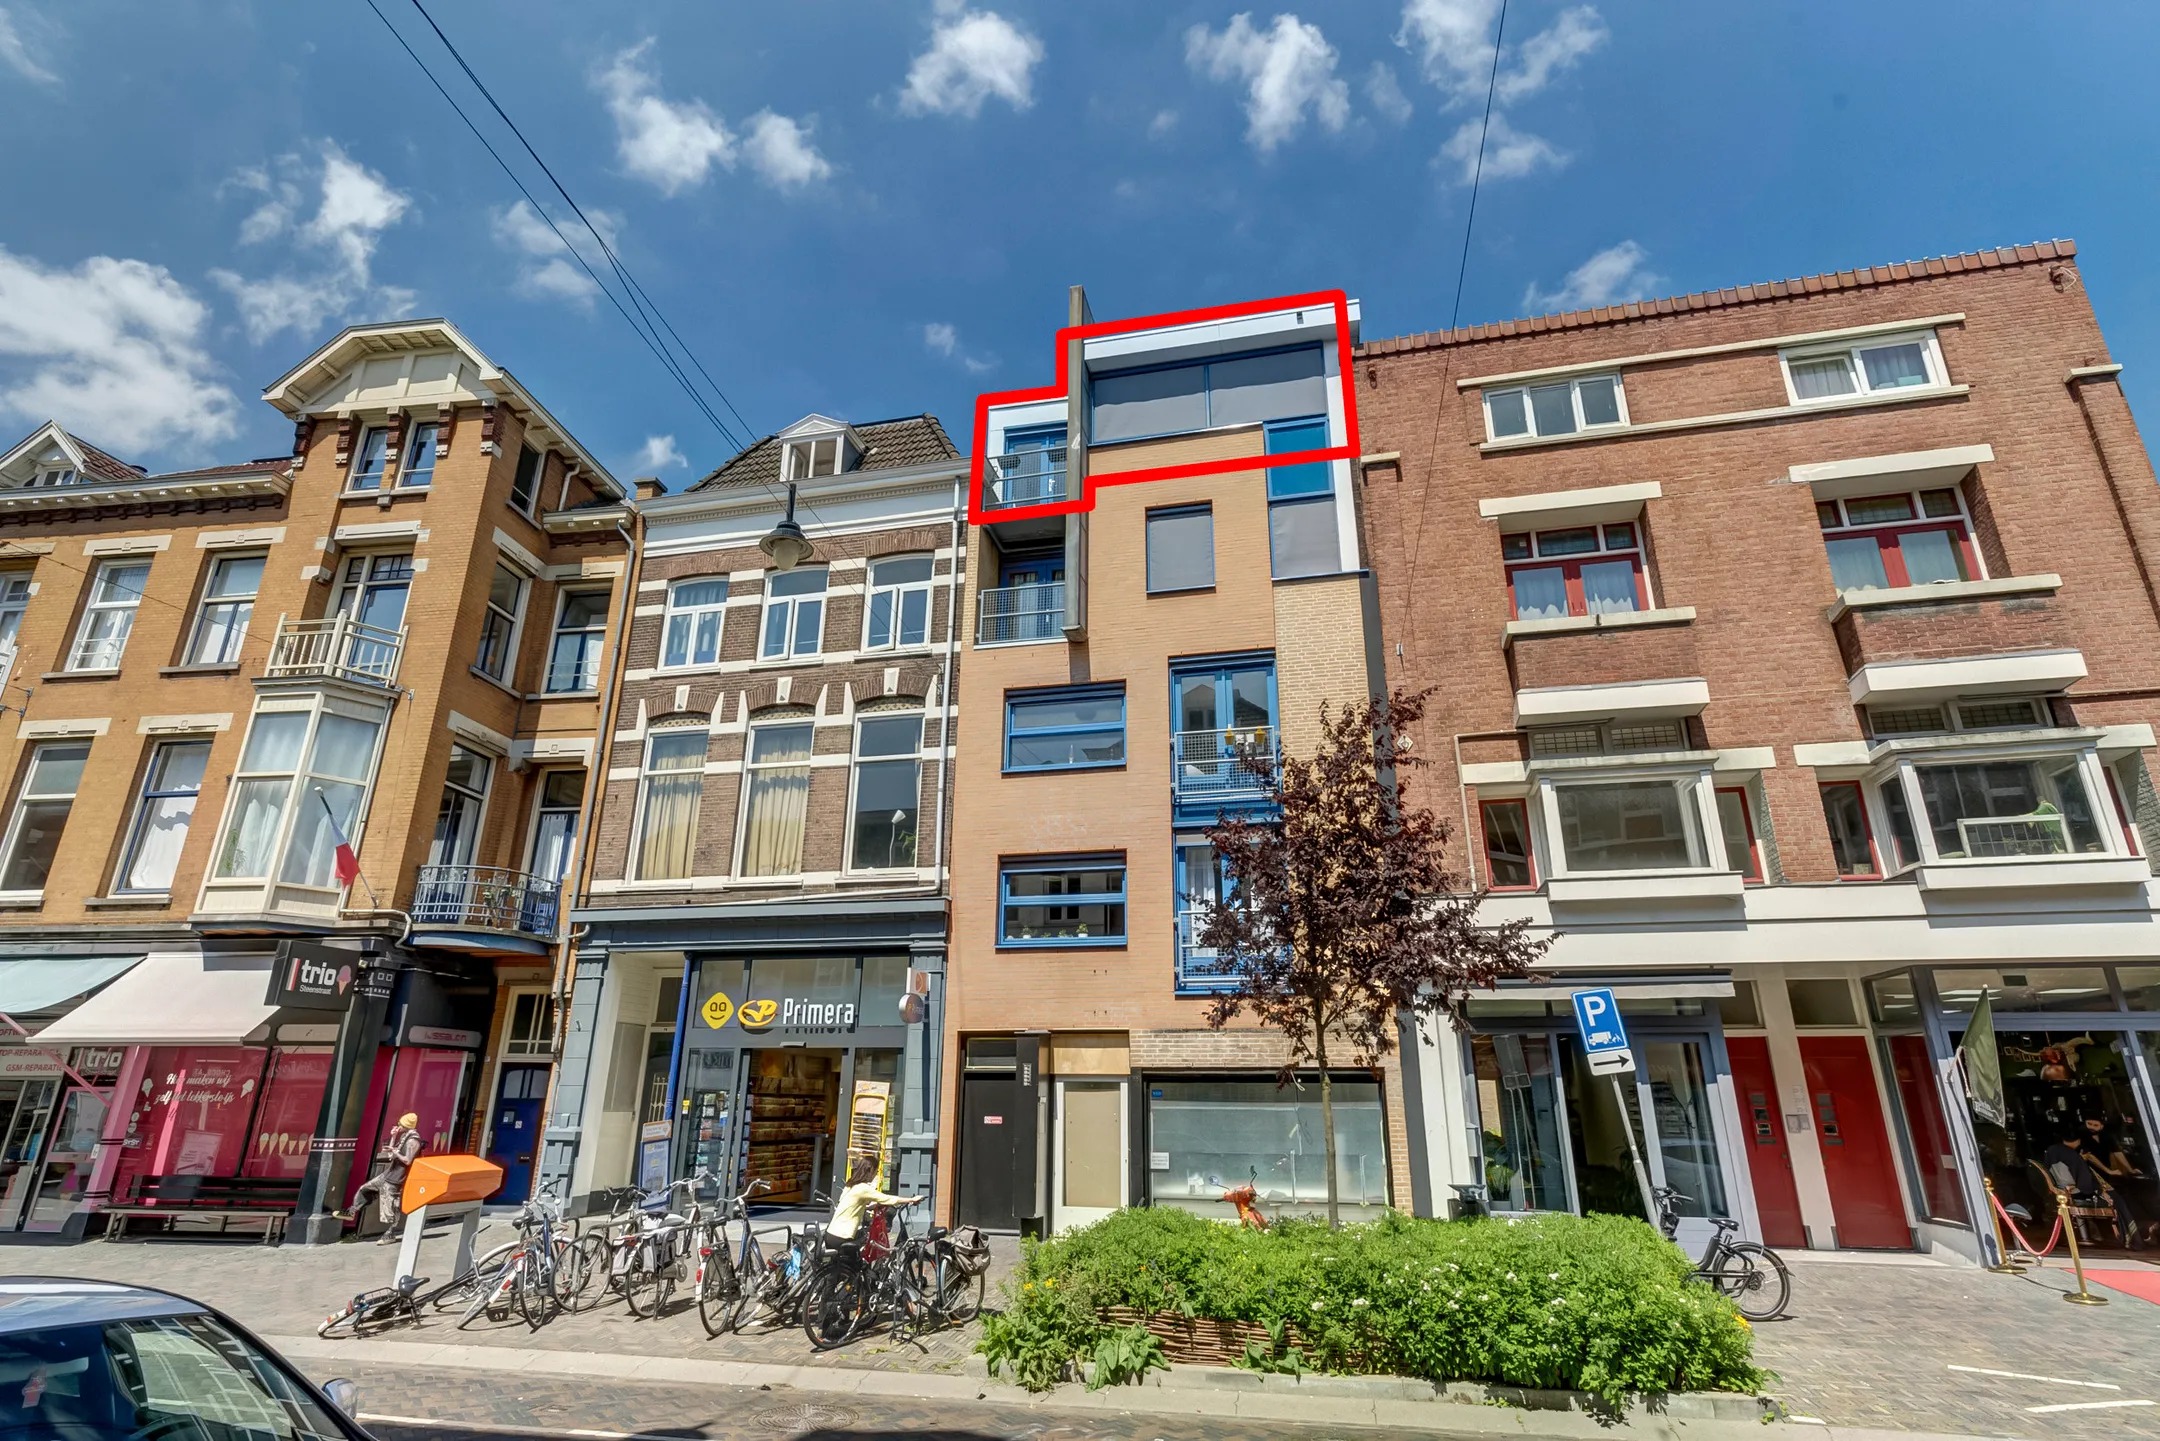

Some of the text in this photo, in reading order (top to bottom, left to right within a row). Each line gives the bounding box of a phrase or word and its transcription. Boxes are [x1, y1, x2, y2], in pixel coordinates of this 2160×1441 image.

[301, 960, 337, 986] trio
[300, 984, 332, 995] Steenstraat
[783, 998, 854, 1025] Primera
[1583, 996, 1606, 1027] P
